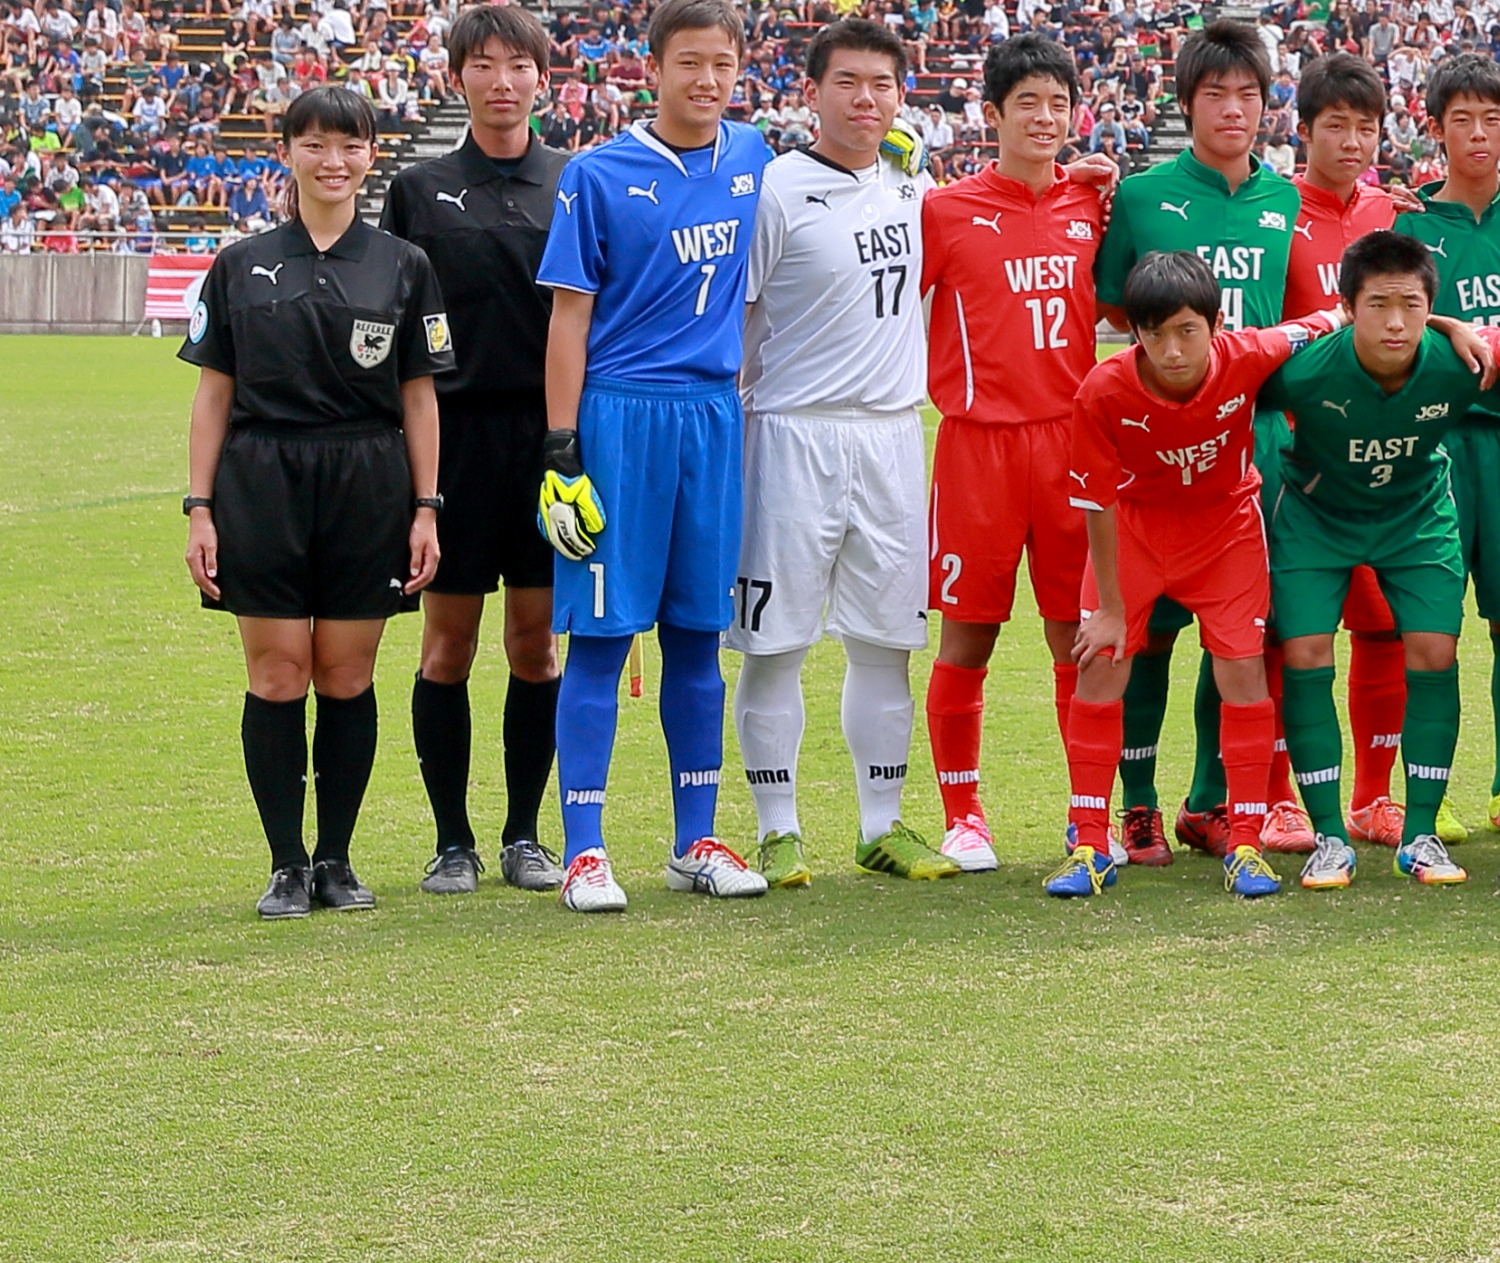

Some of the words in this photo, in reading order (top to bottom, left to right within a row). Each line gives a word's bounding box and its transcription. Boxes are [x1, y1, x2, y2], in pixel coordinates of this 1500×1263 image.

[731, 174, 755, 194] JCY
[1066, 219, 1093, 240] JCY
[1258, 211, 1286, 231] JCY
[671, 220, 739, 264] WEST
[855, 223, 911, 265] EAST
[1003, 254, 1078, 293] WEST
[1196, 246, 1265, 280] EAST
[871, 265, 907, 318] 17
[356, 322, 392, 335] REFEREE
[1025, 297, 1068, 350] 12
[1215, 394, 1246, 422] JCY
[1414, 402, 1449, 423] JCY
[1348, 436, 1419, 464] EAST
[1369, 465, 1393, 489] 3
[589, 563, 604, 617] 1
[738, 577, 771, 631] 17
[1409, 763, 1451, 781] PUM
[1234, 802, 1267, 815] PUM
